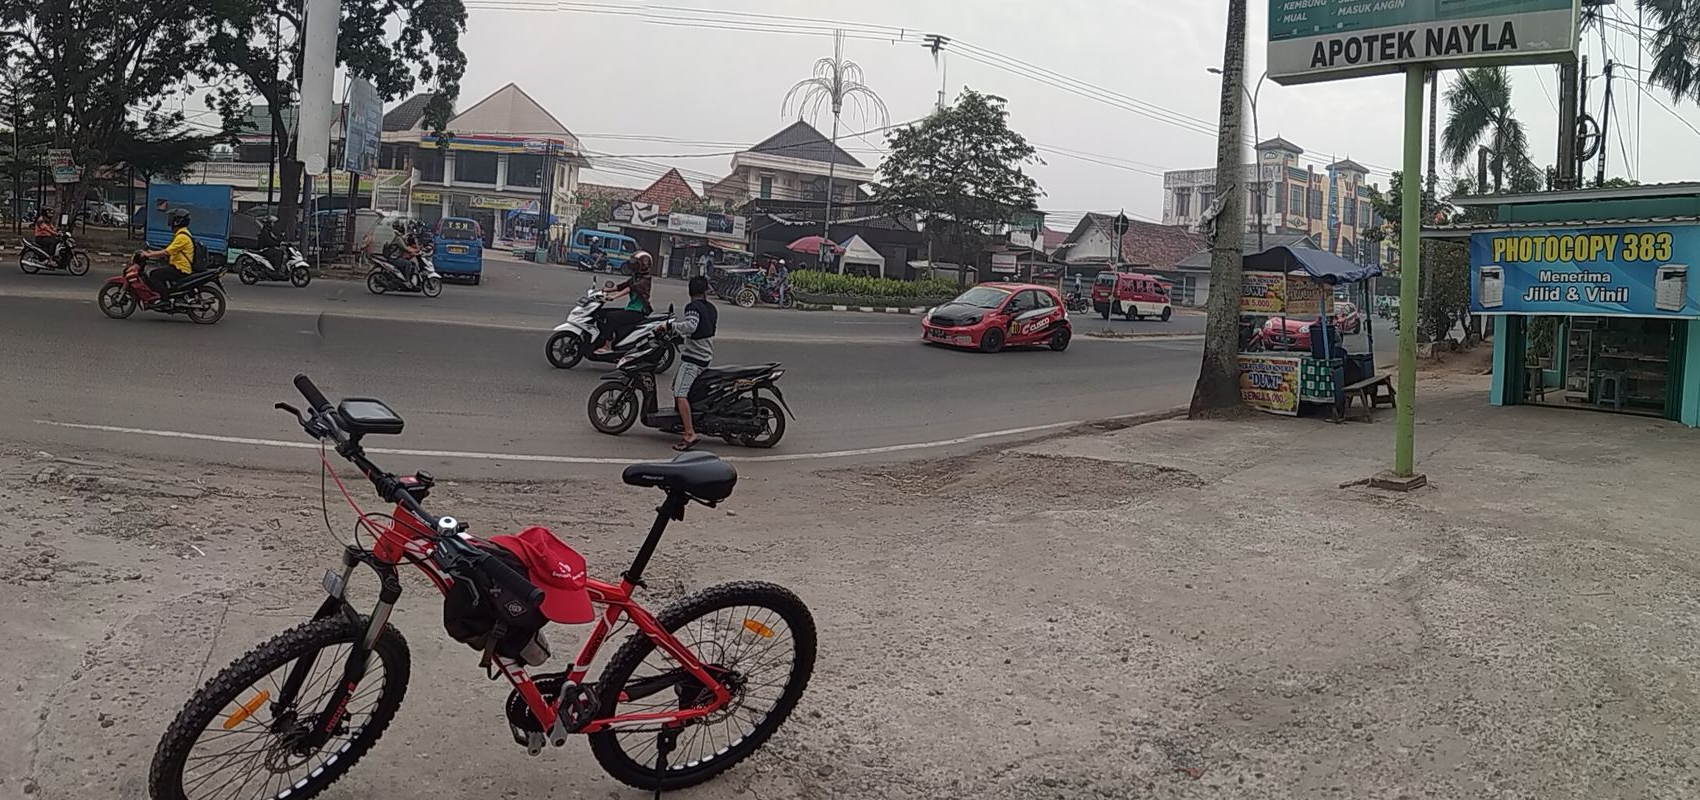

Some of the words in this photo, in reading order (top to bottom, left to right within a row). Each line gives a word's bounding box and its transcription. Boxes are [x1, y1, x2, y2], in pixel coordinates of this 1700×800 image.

[1337, 3, 1371, 17] MASUK
[1373, 0, 1405, 12] ANGIN
[1283, 12, 1308, 24] MUAL
[1310, 30, 1417, 68] APOTEK
[1425, 21, 1518, 57] NAYLA
[1493, 235, 1618, 263] PHOTOCOPY
[1622, 232, 1674, 262] 383
[1538, 270, 1611, 283] Menerima
[1523, 286, 1560, 302] Jilid
[1566, 287, 1580, 302] &
[1585, 287, 1628, 302] Vinil
